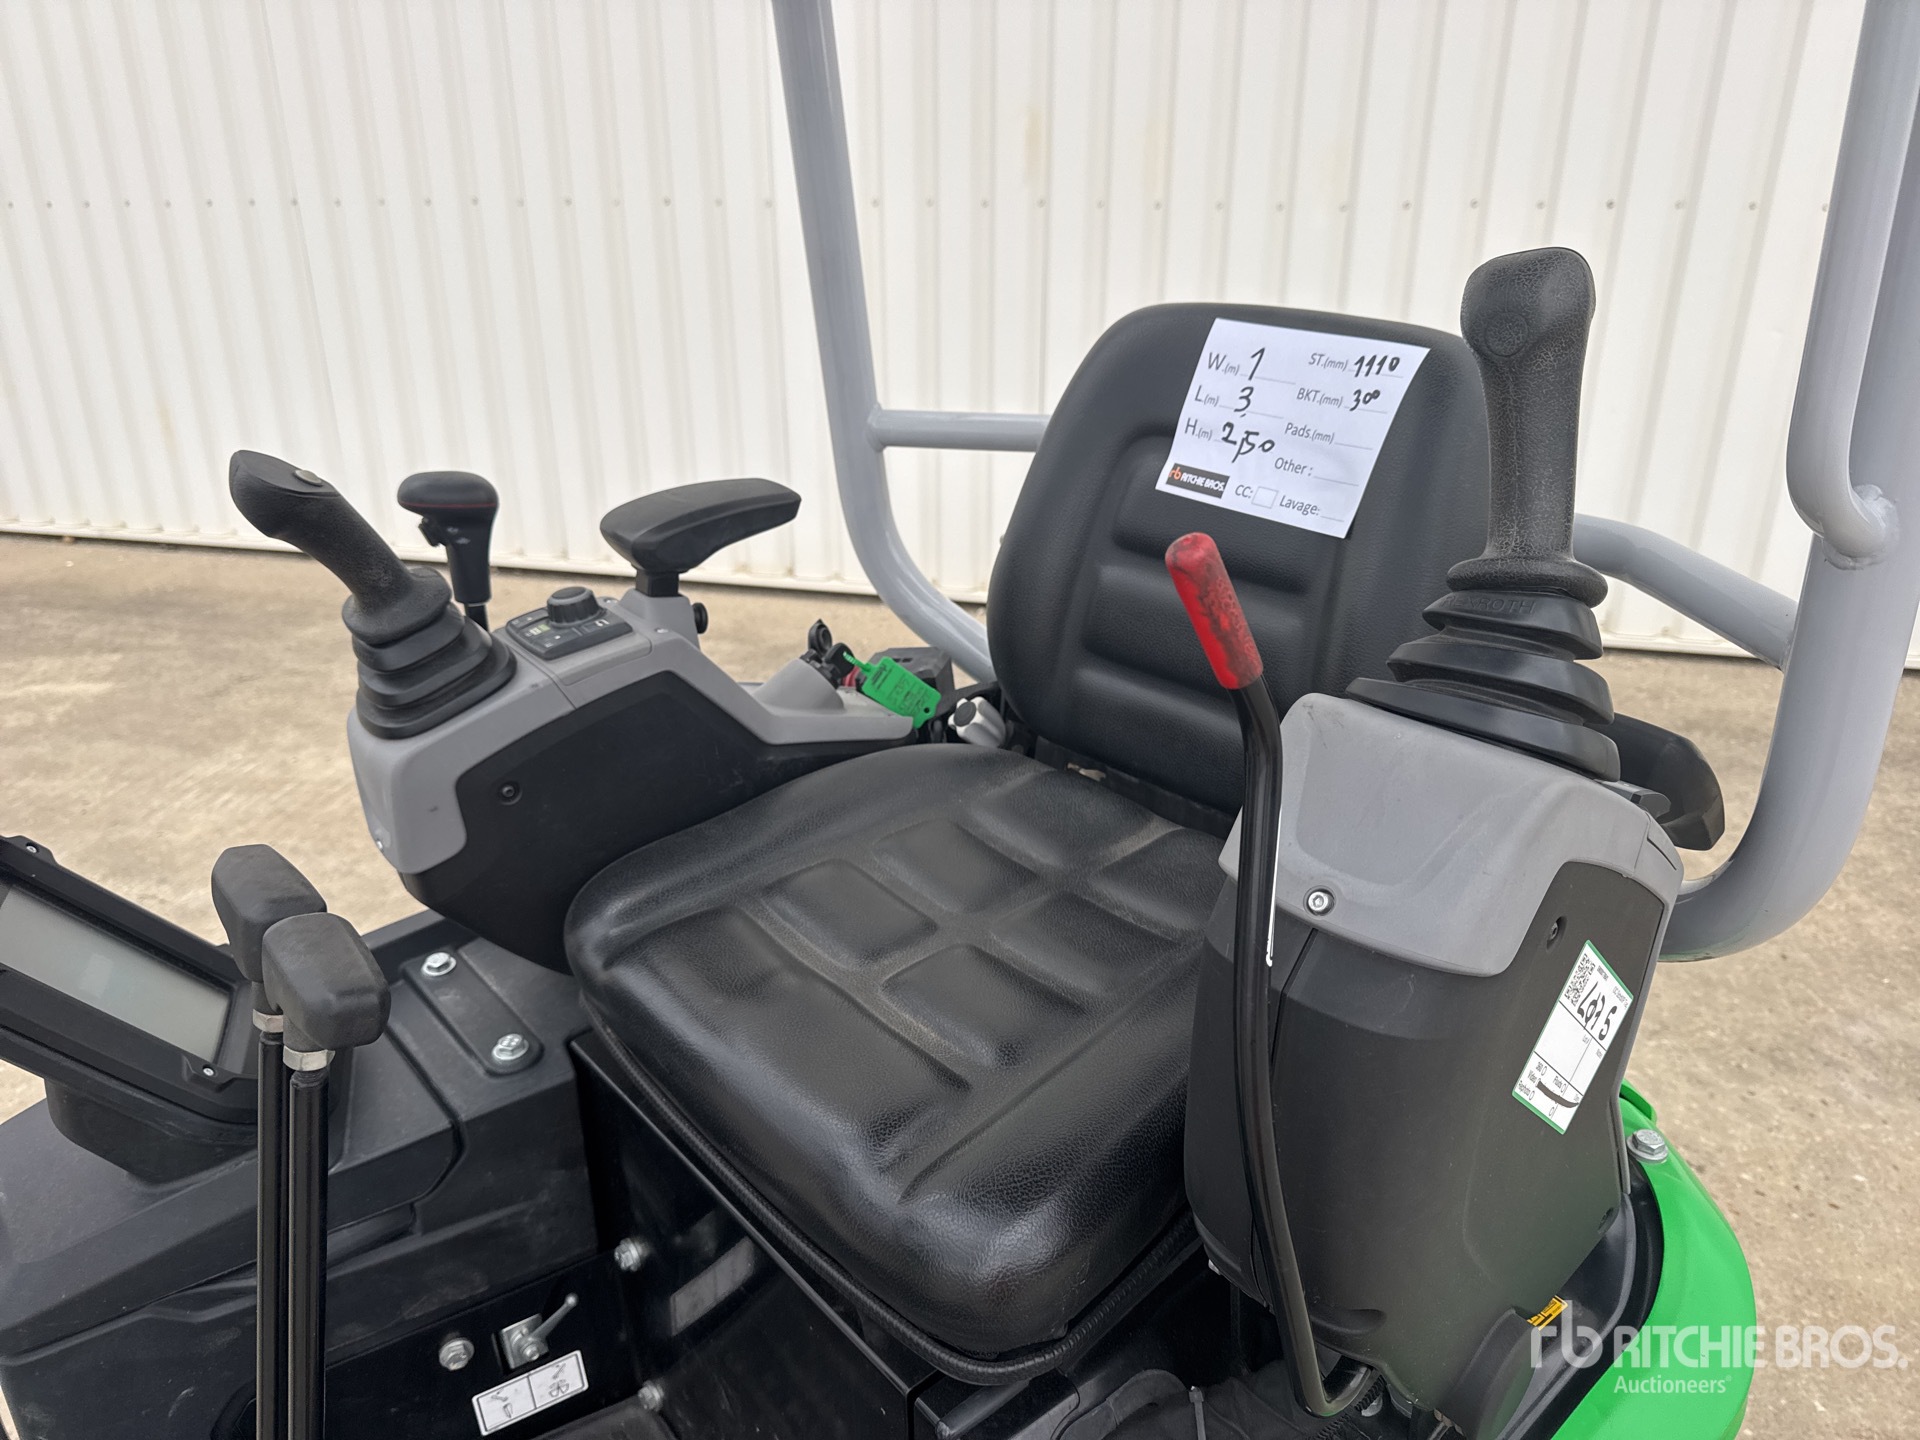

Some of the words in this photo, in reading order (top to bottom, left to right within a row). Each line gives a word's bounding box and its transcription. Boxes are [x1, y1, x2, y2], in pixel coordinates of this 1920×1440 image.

[1249, 347, 1266, 381] 1
[1353, 354, 1400, 378] 1110
[1279, 495, 1320, 516] Lavage:
